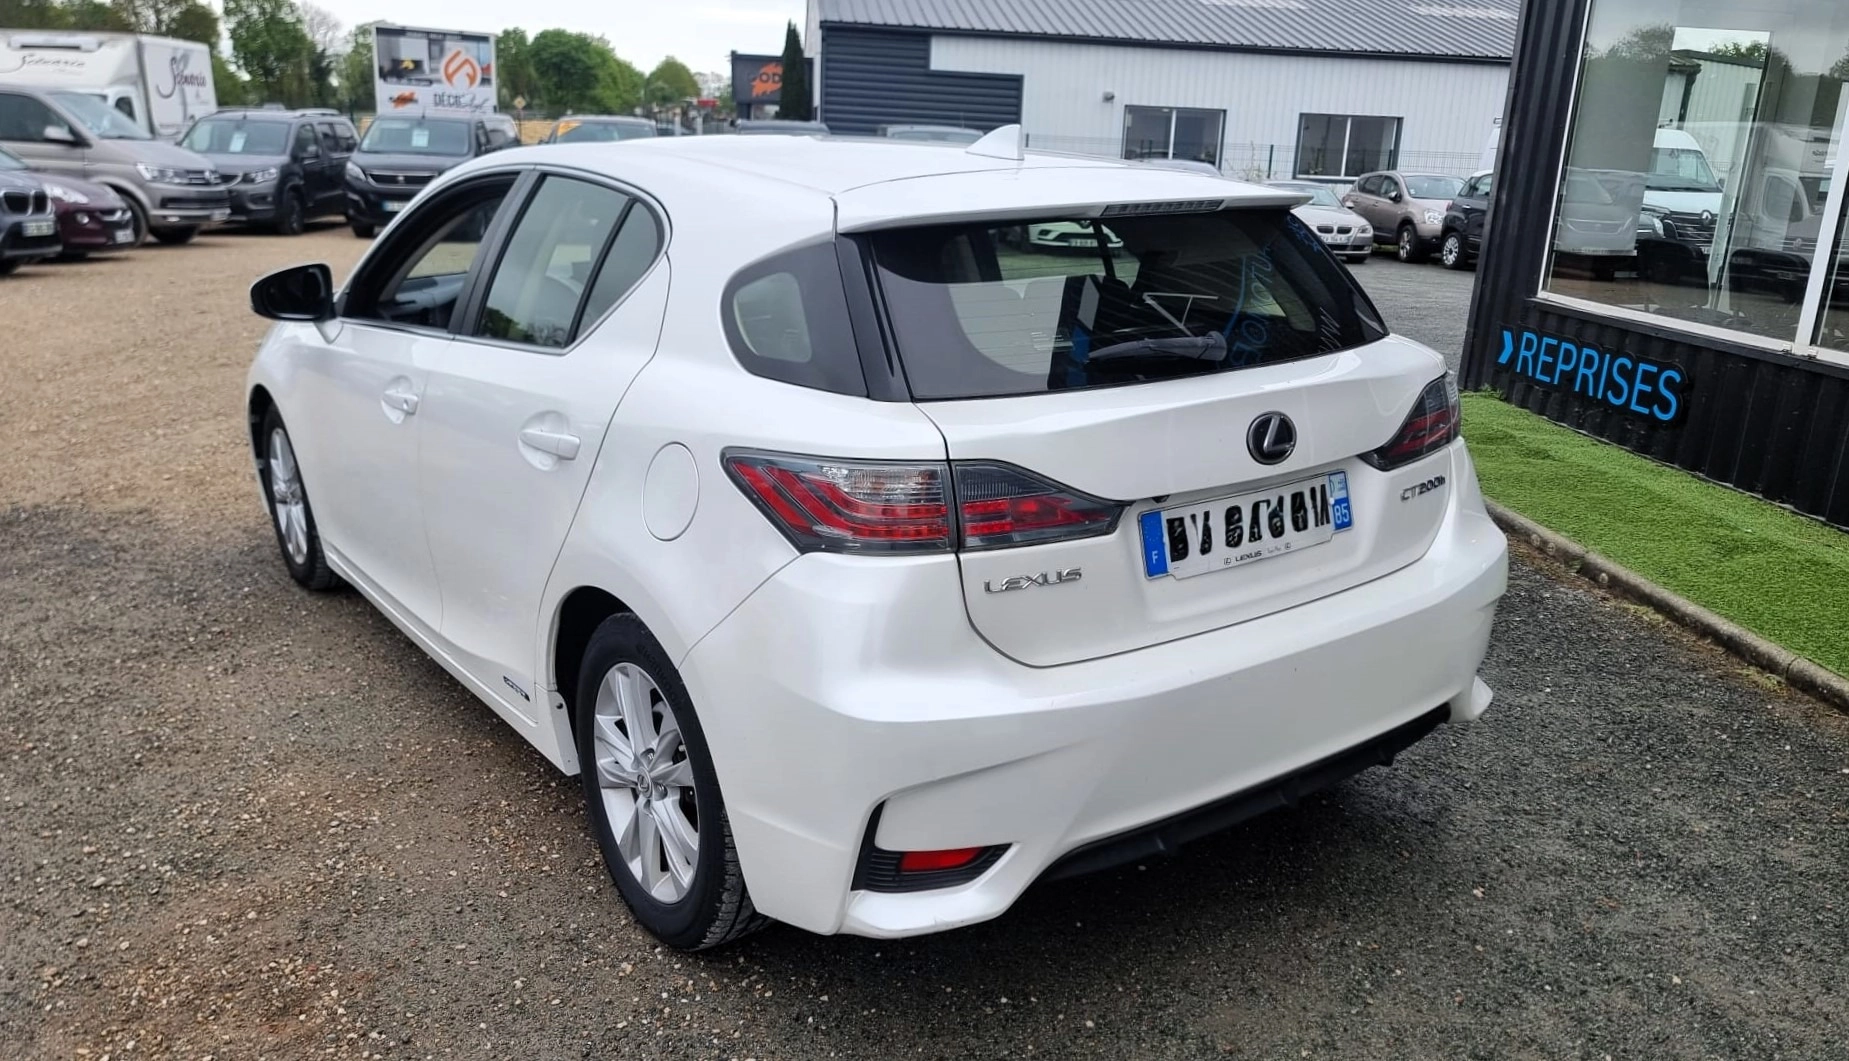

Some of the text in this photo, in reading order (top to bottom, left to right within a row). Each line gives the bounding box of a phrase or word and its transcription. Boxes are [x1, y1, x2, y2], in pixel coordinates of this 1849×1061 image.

[1516, 331, 1682, 421] REPRISES
[1334, 503, 1351, 525] 85
[1151, 550, 1159, 565] F
[1235, 549, 1263, 562] LEXUS
[983, 567, 1082, 594] LEXUS
